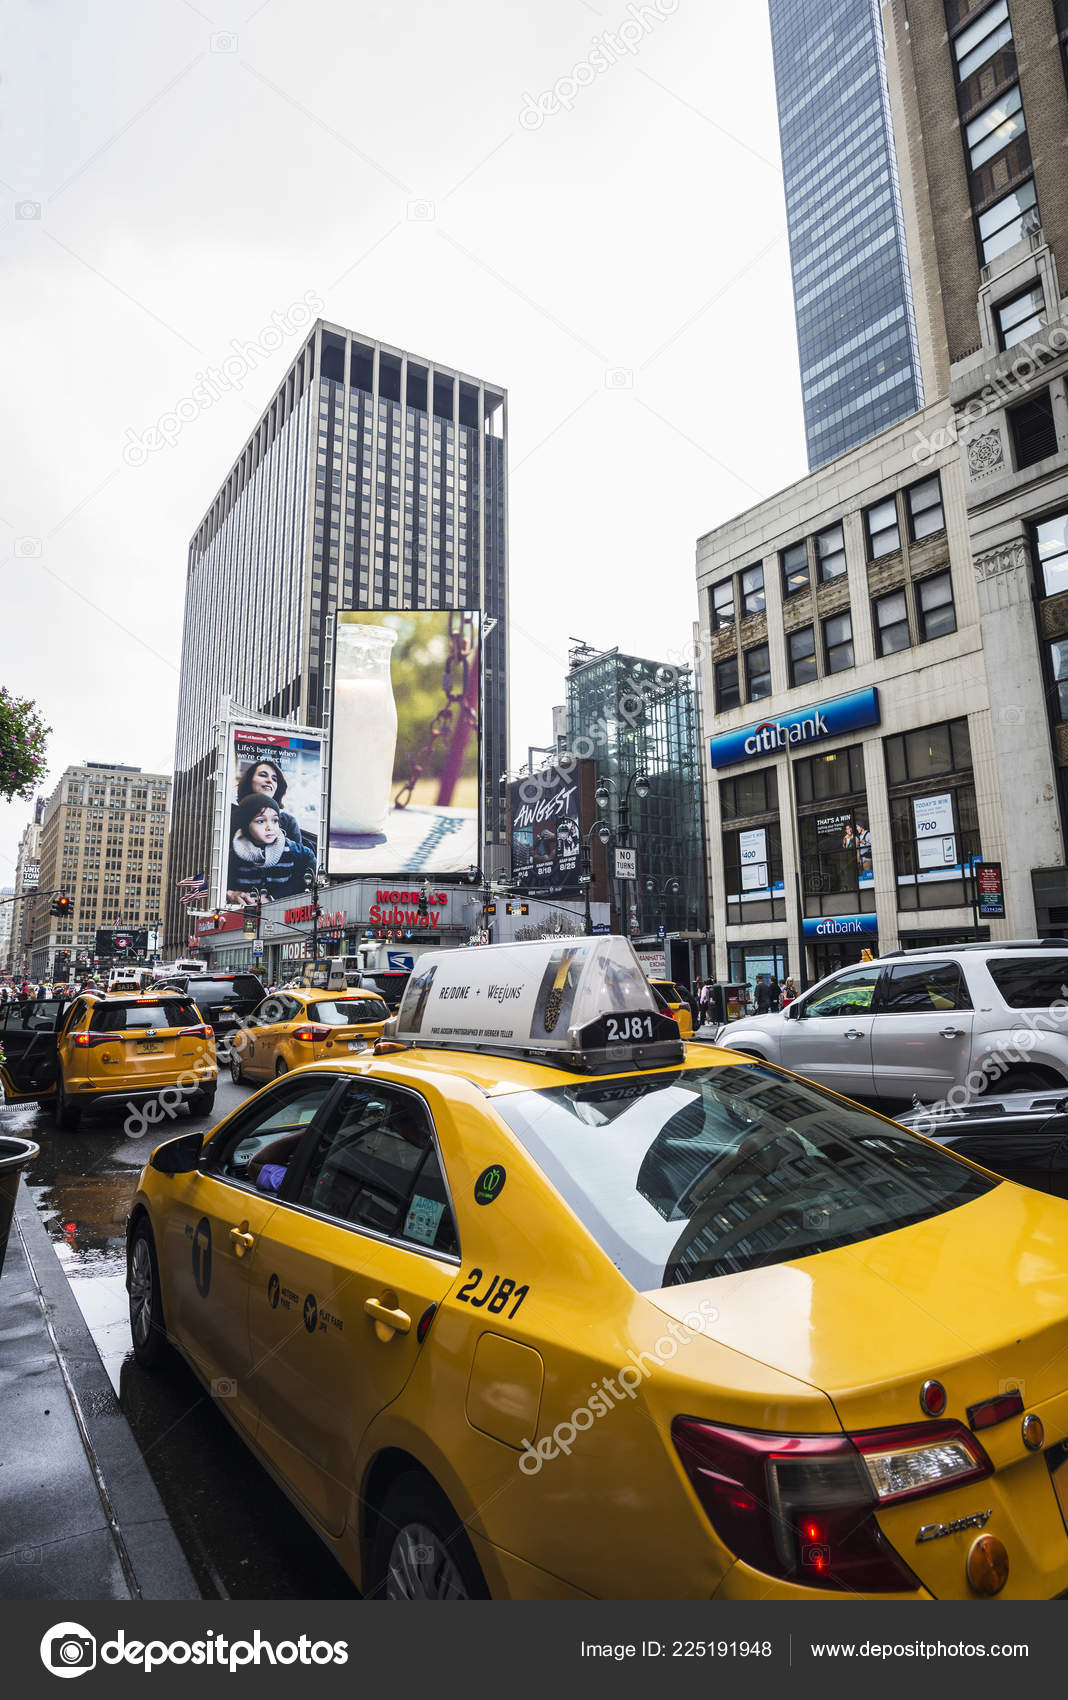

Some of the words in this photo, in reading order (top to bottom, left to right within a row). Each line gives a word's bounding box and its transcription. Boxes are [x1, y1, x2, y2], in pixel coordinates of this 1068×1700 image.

[744, 711, 829, 755] citibank
[237, 744, 255, 753] Life's
[256, 747, 277, 755] better
[620, 852, 631, 860] NO
[559, 862, 576, 871] 8/25
[376, 890, 448, 905] MODEL'S
[369, 905, 440, 929] Subway
[816, 920, 862, 935] citibank
[440, 986, 470, 999] RE/DONE
[606, 1016, 653, 1040] 2J81
[456, 1268, 529, 1319] 2J81
